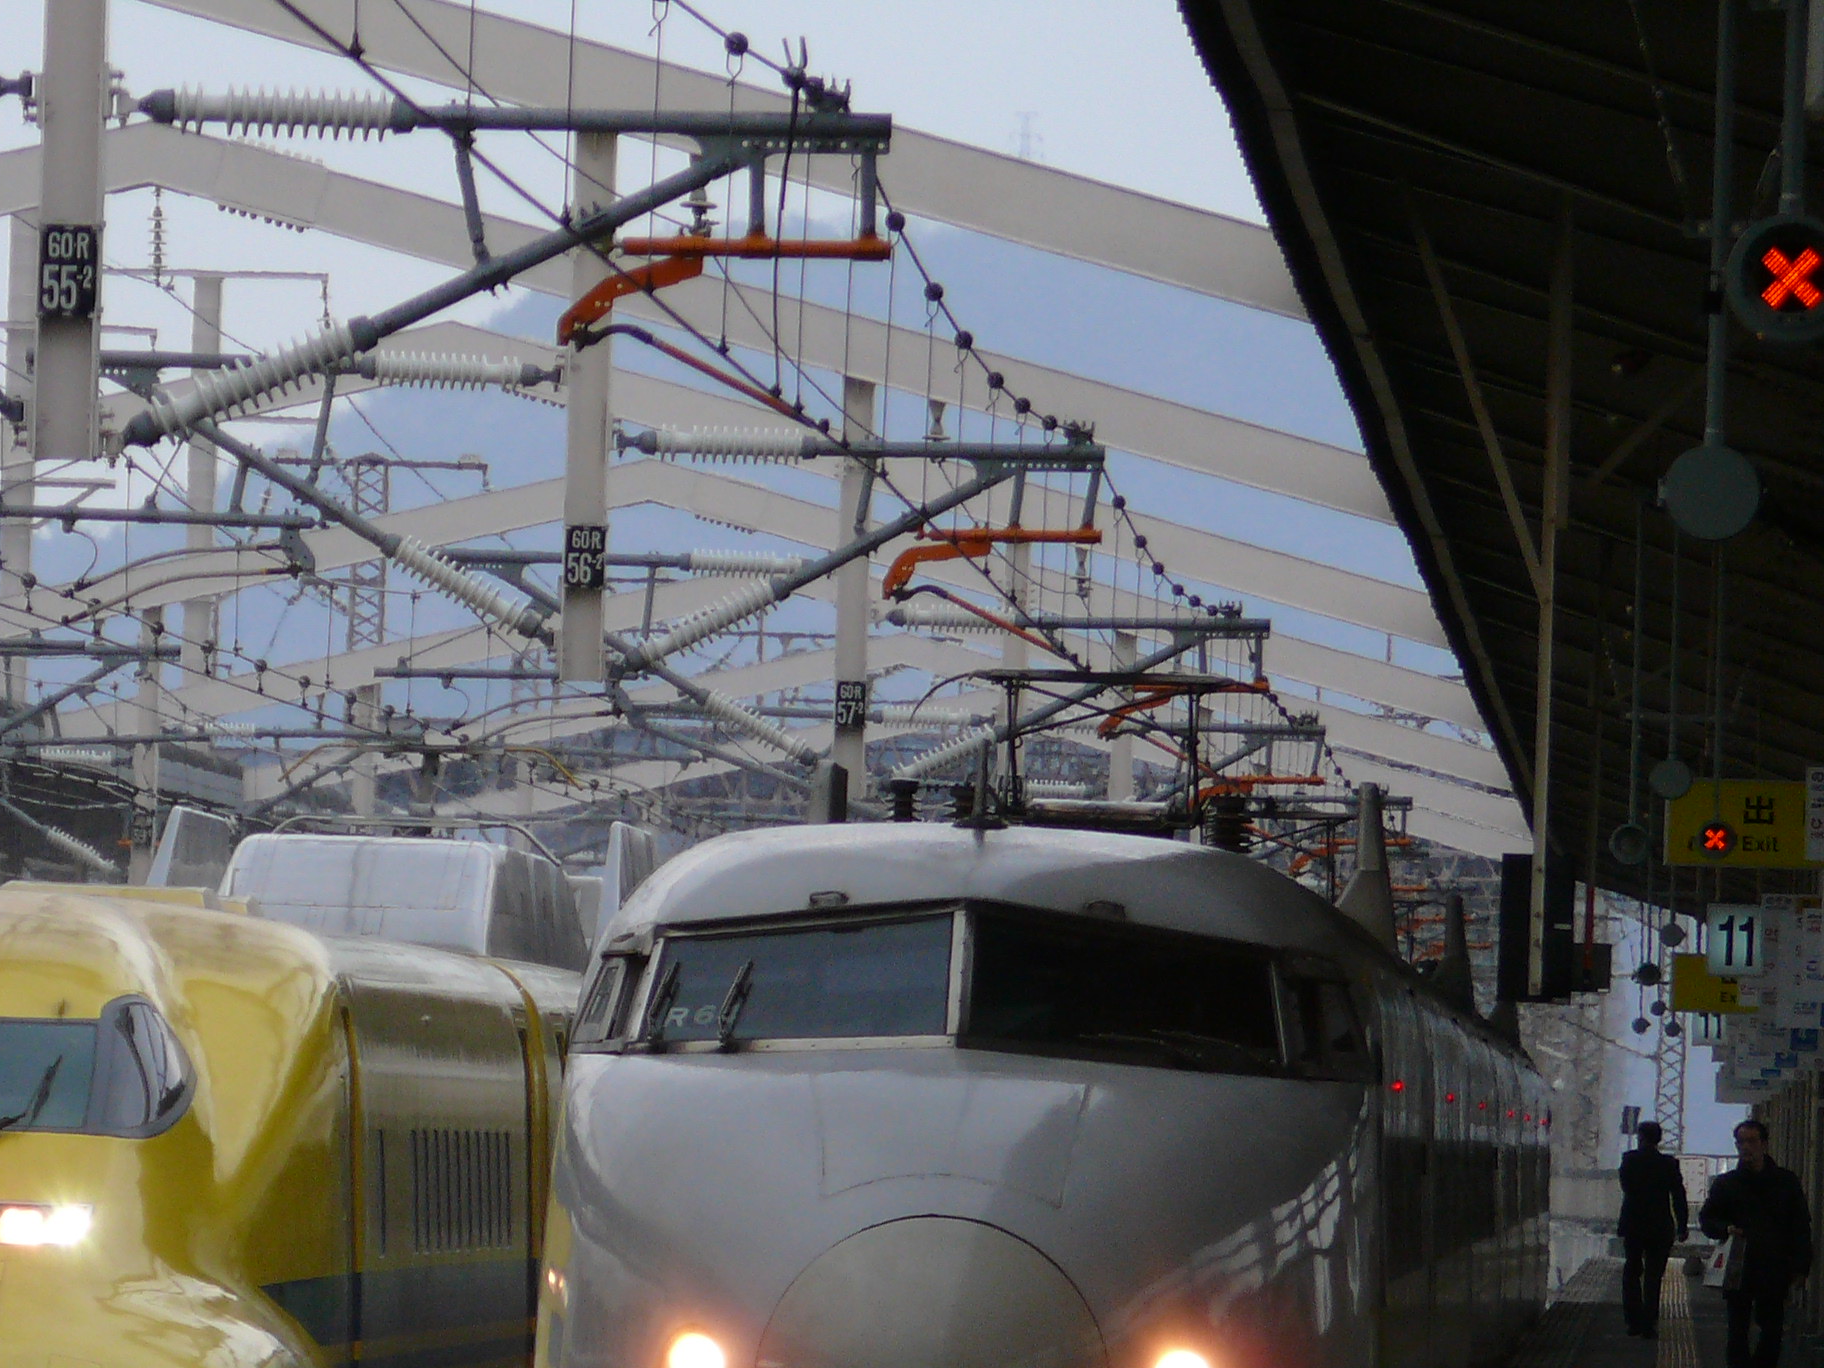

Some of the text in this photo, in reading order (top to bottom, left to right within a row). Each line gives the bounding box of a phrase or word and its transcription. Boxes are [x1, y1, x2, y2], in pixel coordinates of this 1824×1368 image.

[48, 231, 89, 260] 60R
[41, 263, 93, 310] 55-2
[572, 530, 601, 550] 60R
[567, 552, 604, 584] 56-2
[840, 684, 862, 700] 60R
[837, 701, 864, 725] 57-2
[1742, 835, 1780, 852] Exit
[1718, 915, 1754, 967] 11
